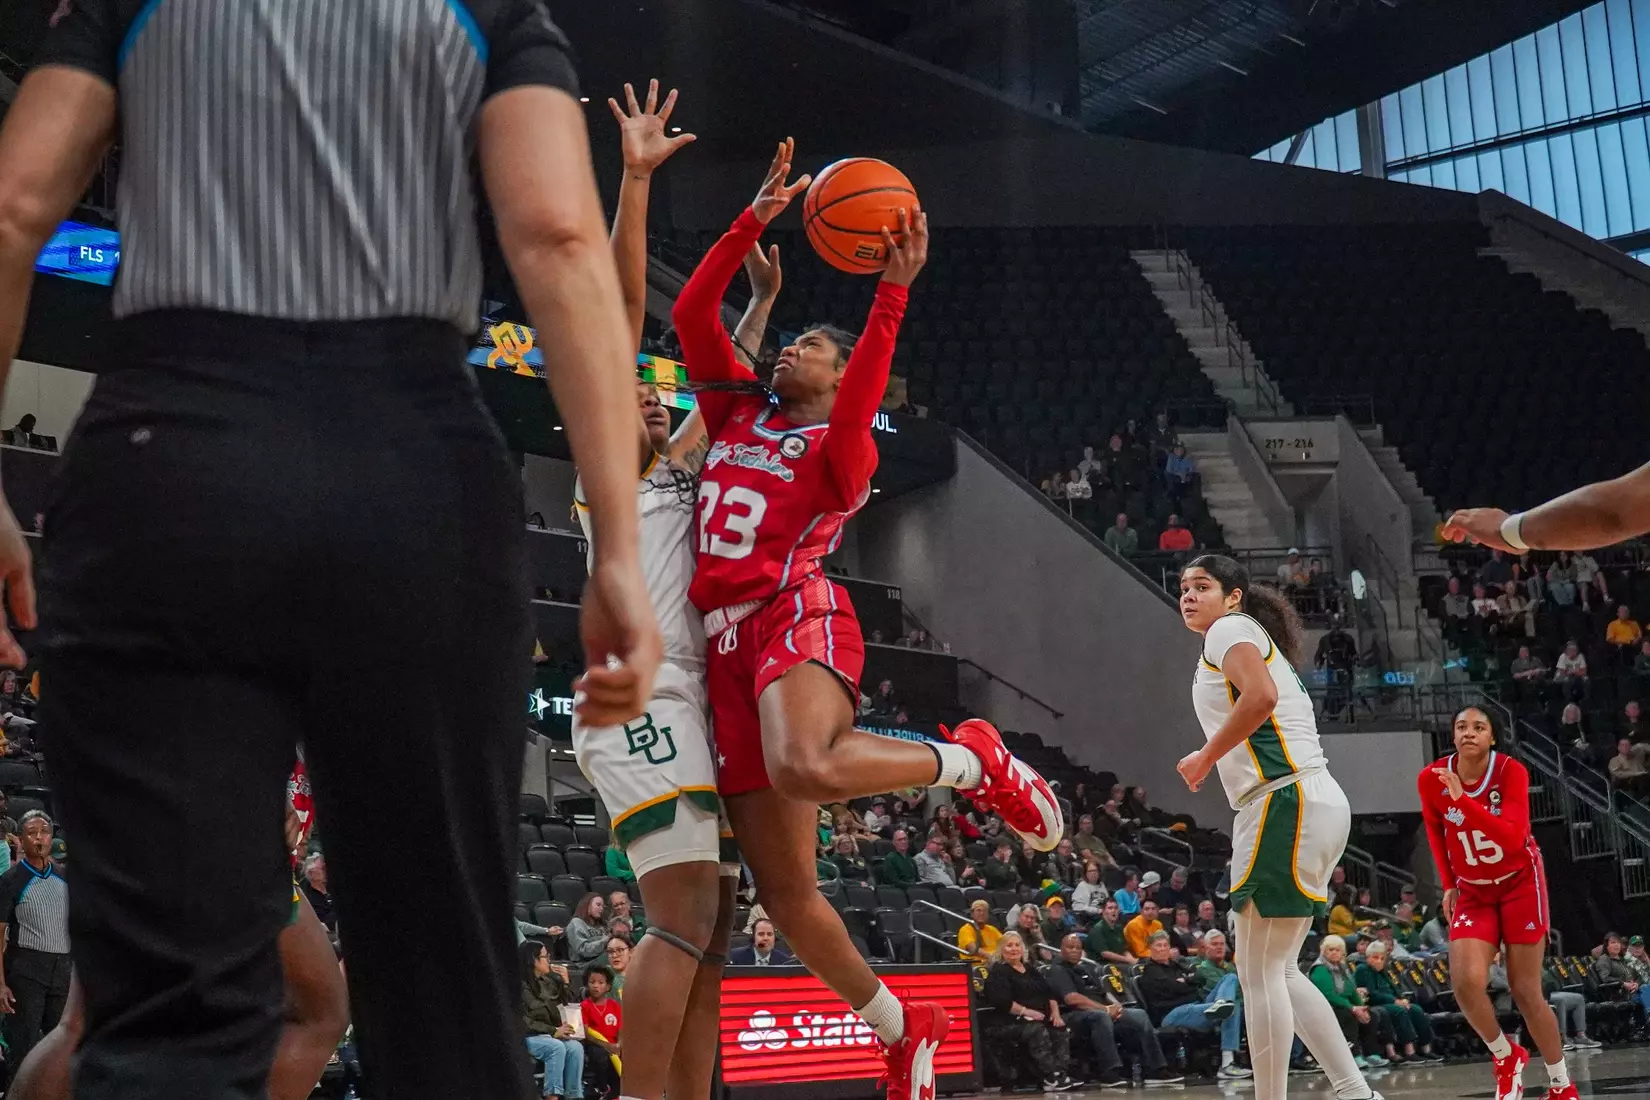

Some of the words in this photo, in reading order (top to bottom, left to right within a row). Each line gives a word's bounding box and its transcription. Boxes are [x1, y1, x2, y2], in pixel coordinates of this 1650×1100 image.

[80, 246, 103, 262] FLS
[1265, 439, 1284, 449] 217
[1295, 438, 1313, 449] 216
[698, 481, 768, 560] 23
[887, 588, 900, 600] 118
[622, 711, 678, 765] BU
[1456, 830, 1504, 866] 15
[791, 1010, 874, 1048] State
